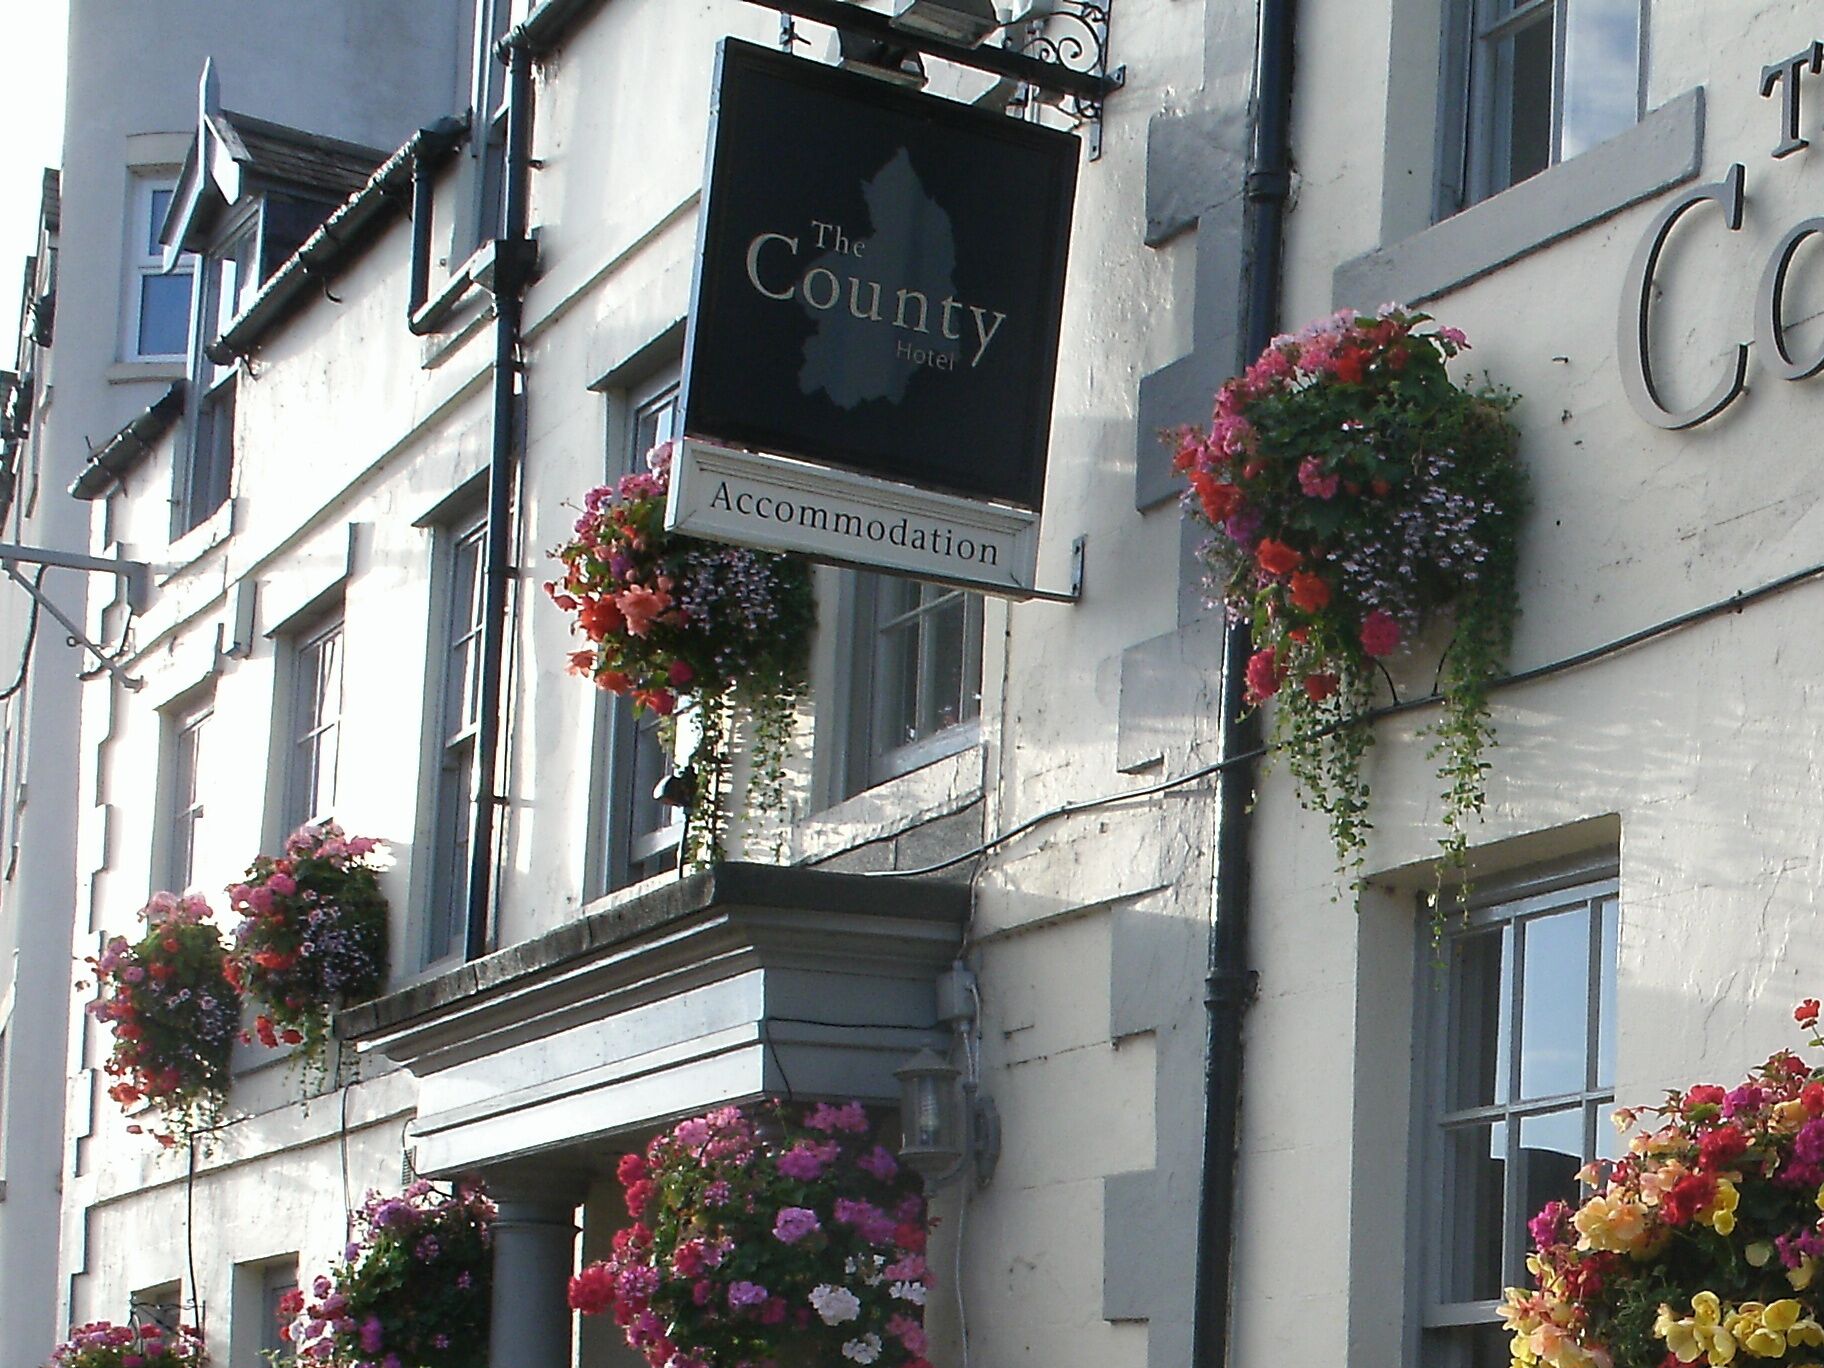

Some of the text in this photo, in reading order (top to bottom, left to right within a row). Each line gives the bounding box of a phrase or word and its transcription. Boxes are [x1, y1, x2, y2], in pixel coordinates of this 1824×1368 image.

[811, 220, 865, 258] The
[746, 232, 1006, 368] County
[896, 340, 956, 372] Hotel
[710, 481, 999, 566] Accommodation
